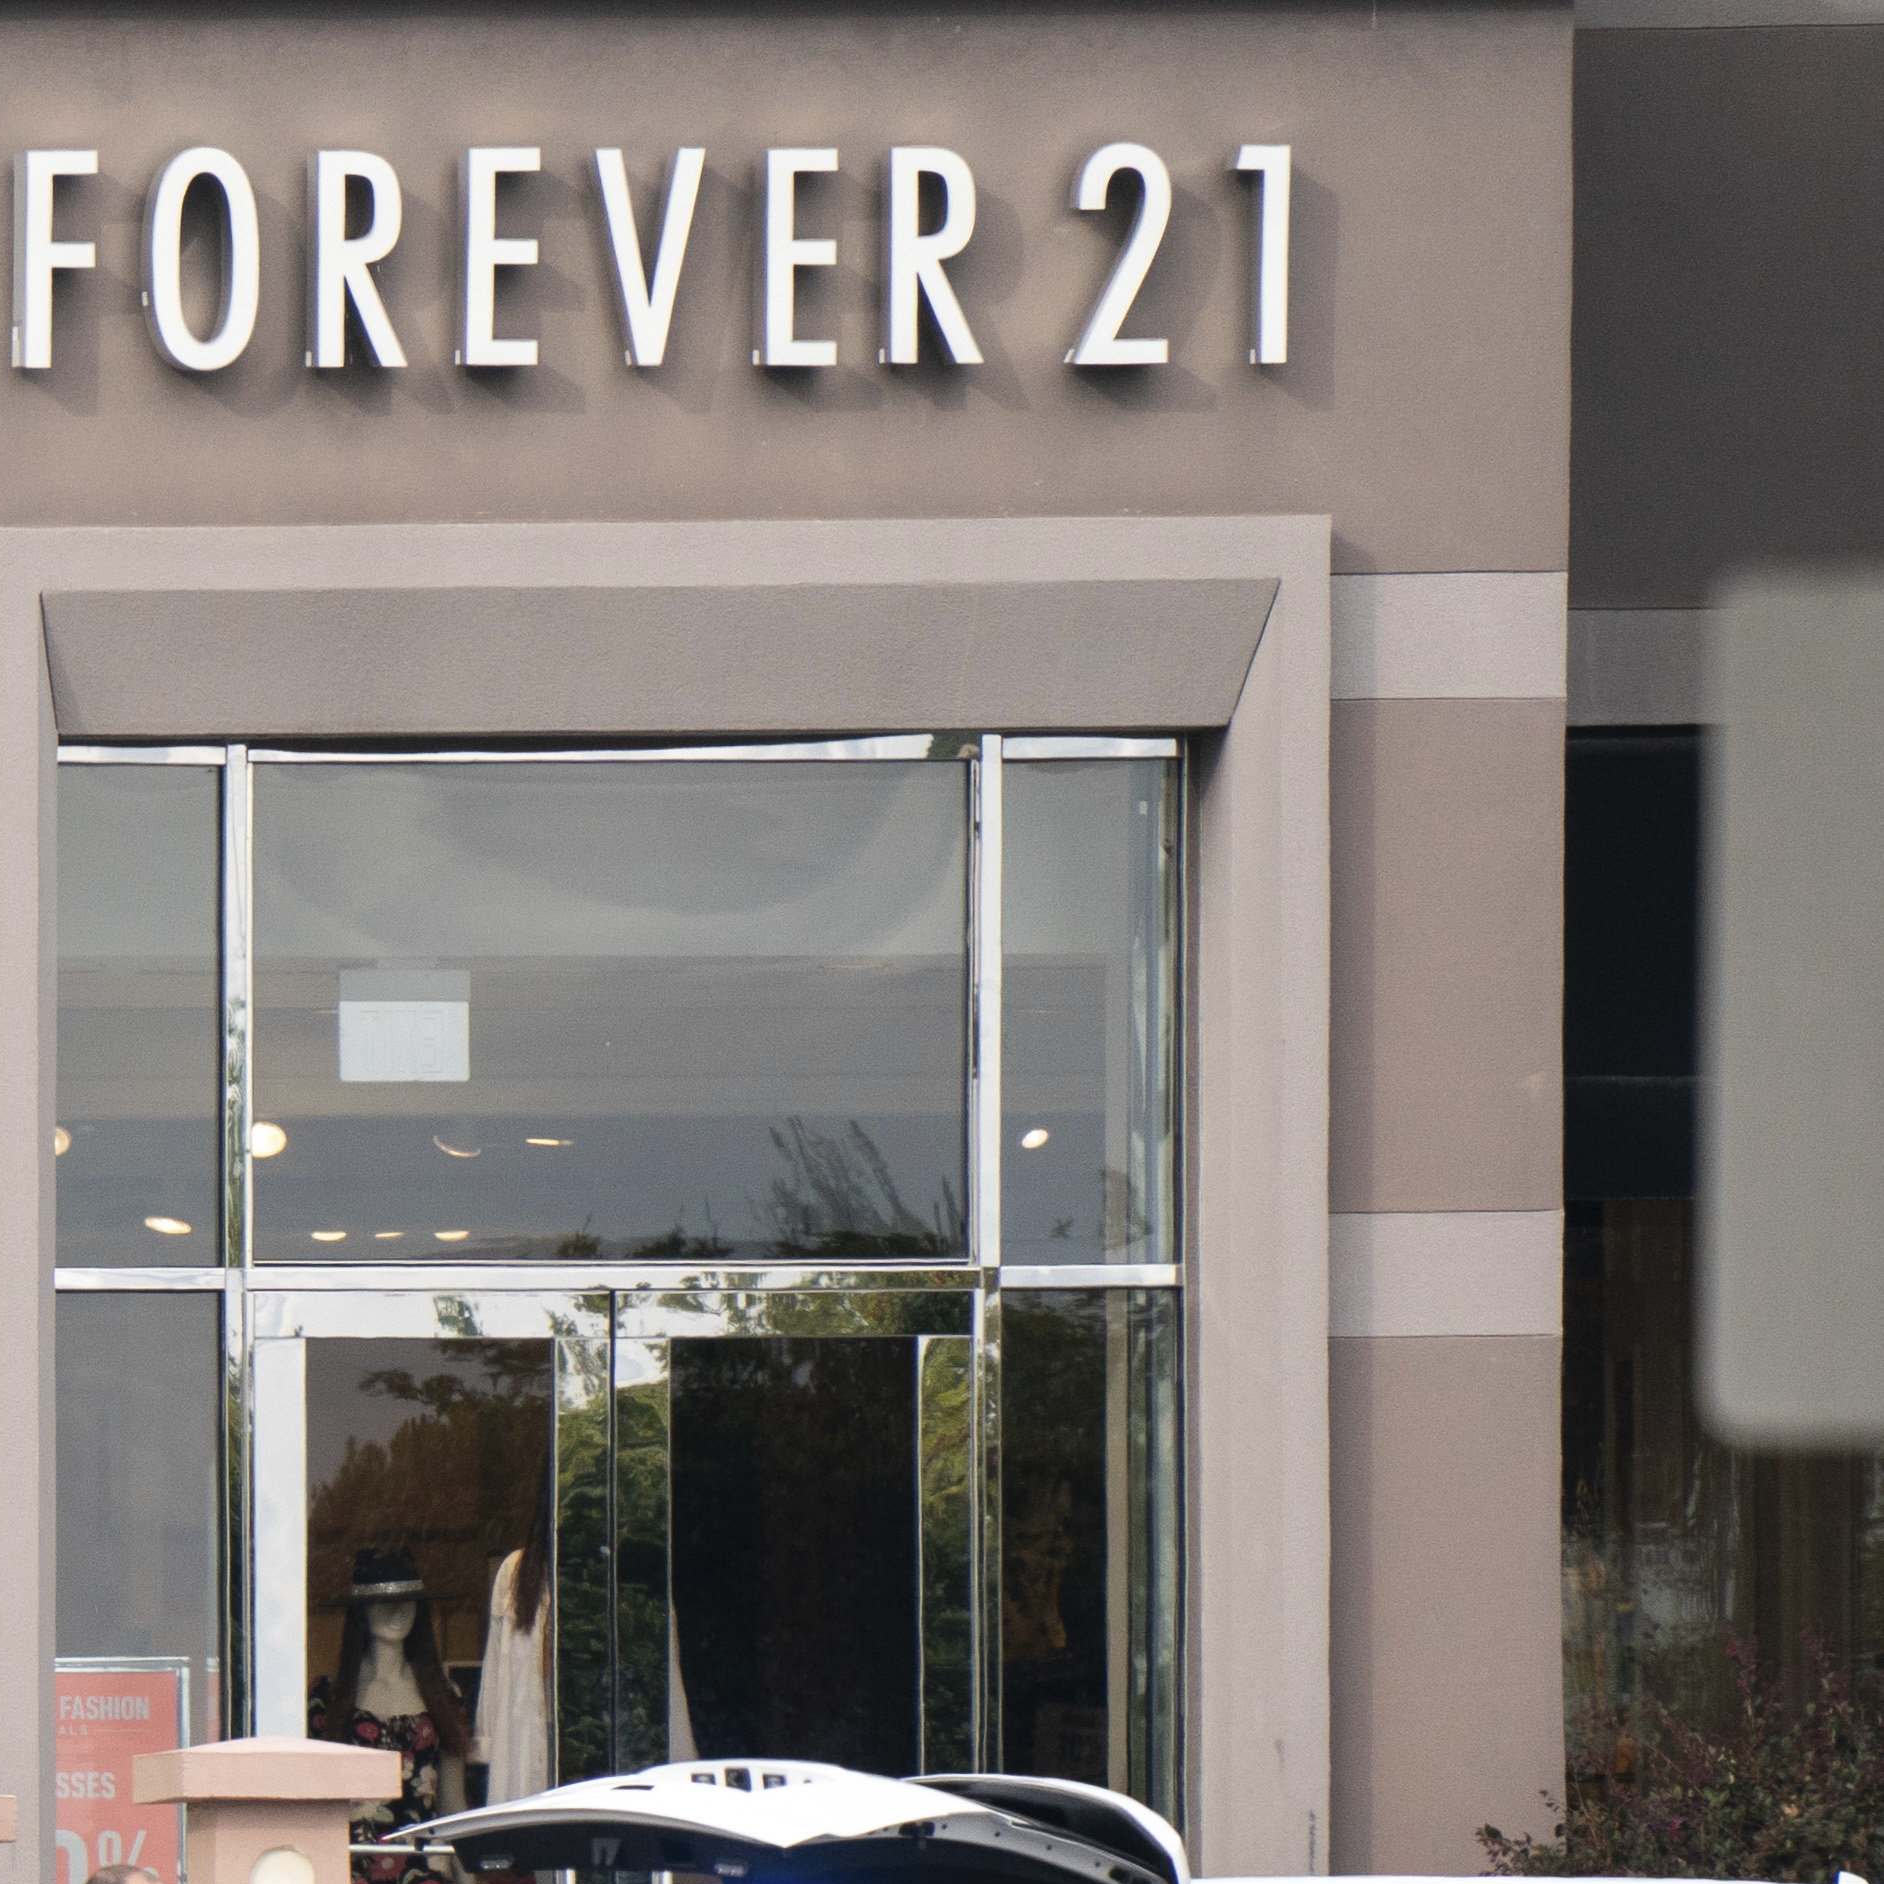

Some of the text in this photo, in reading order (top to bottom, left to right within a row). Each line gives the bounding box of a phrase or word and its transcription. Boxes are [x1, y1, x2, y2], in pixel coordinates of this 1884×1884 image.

[12, 142, 1292, 372] FOREVER 21
[59, 1695, 152, 1721] FASHION
[56, 1771, 116, 1800] SSES
